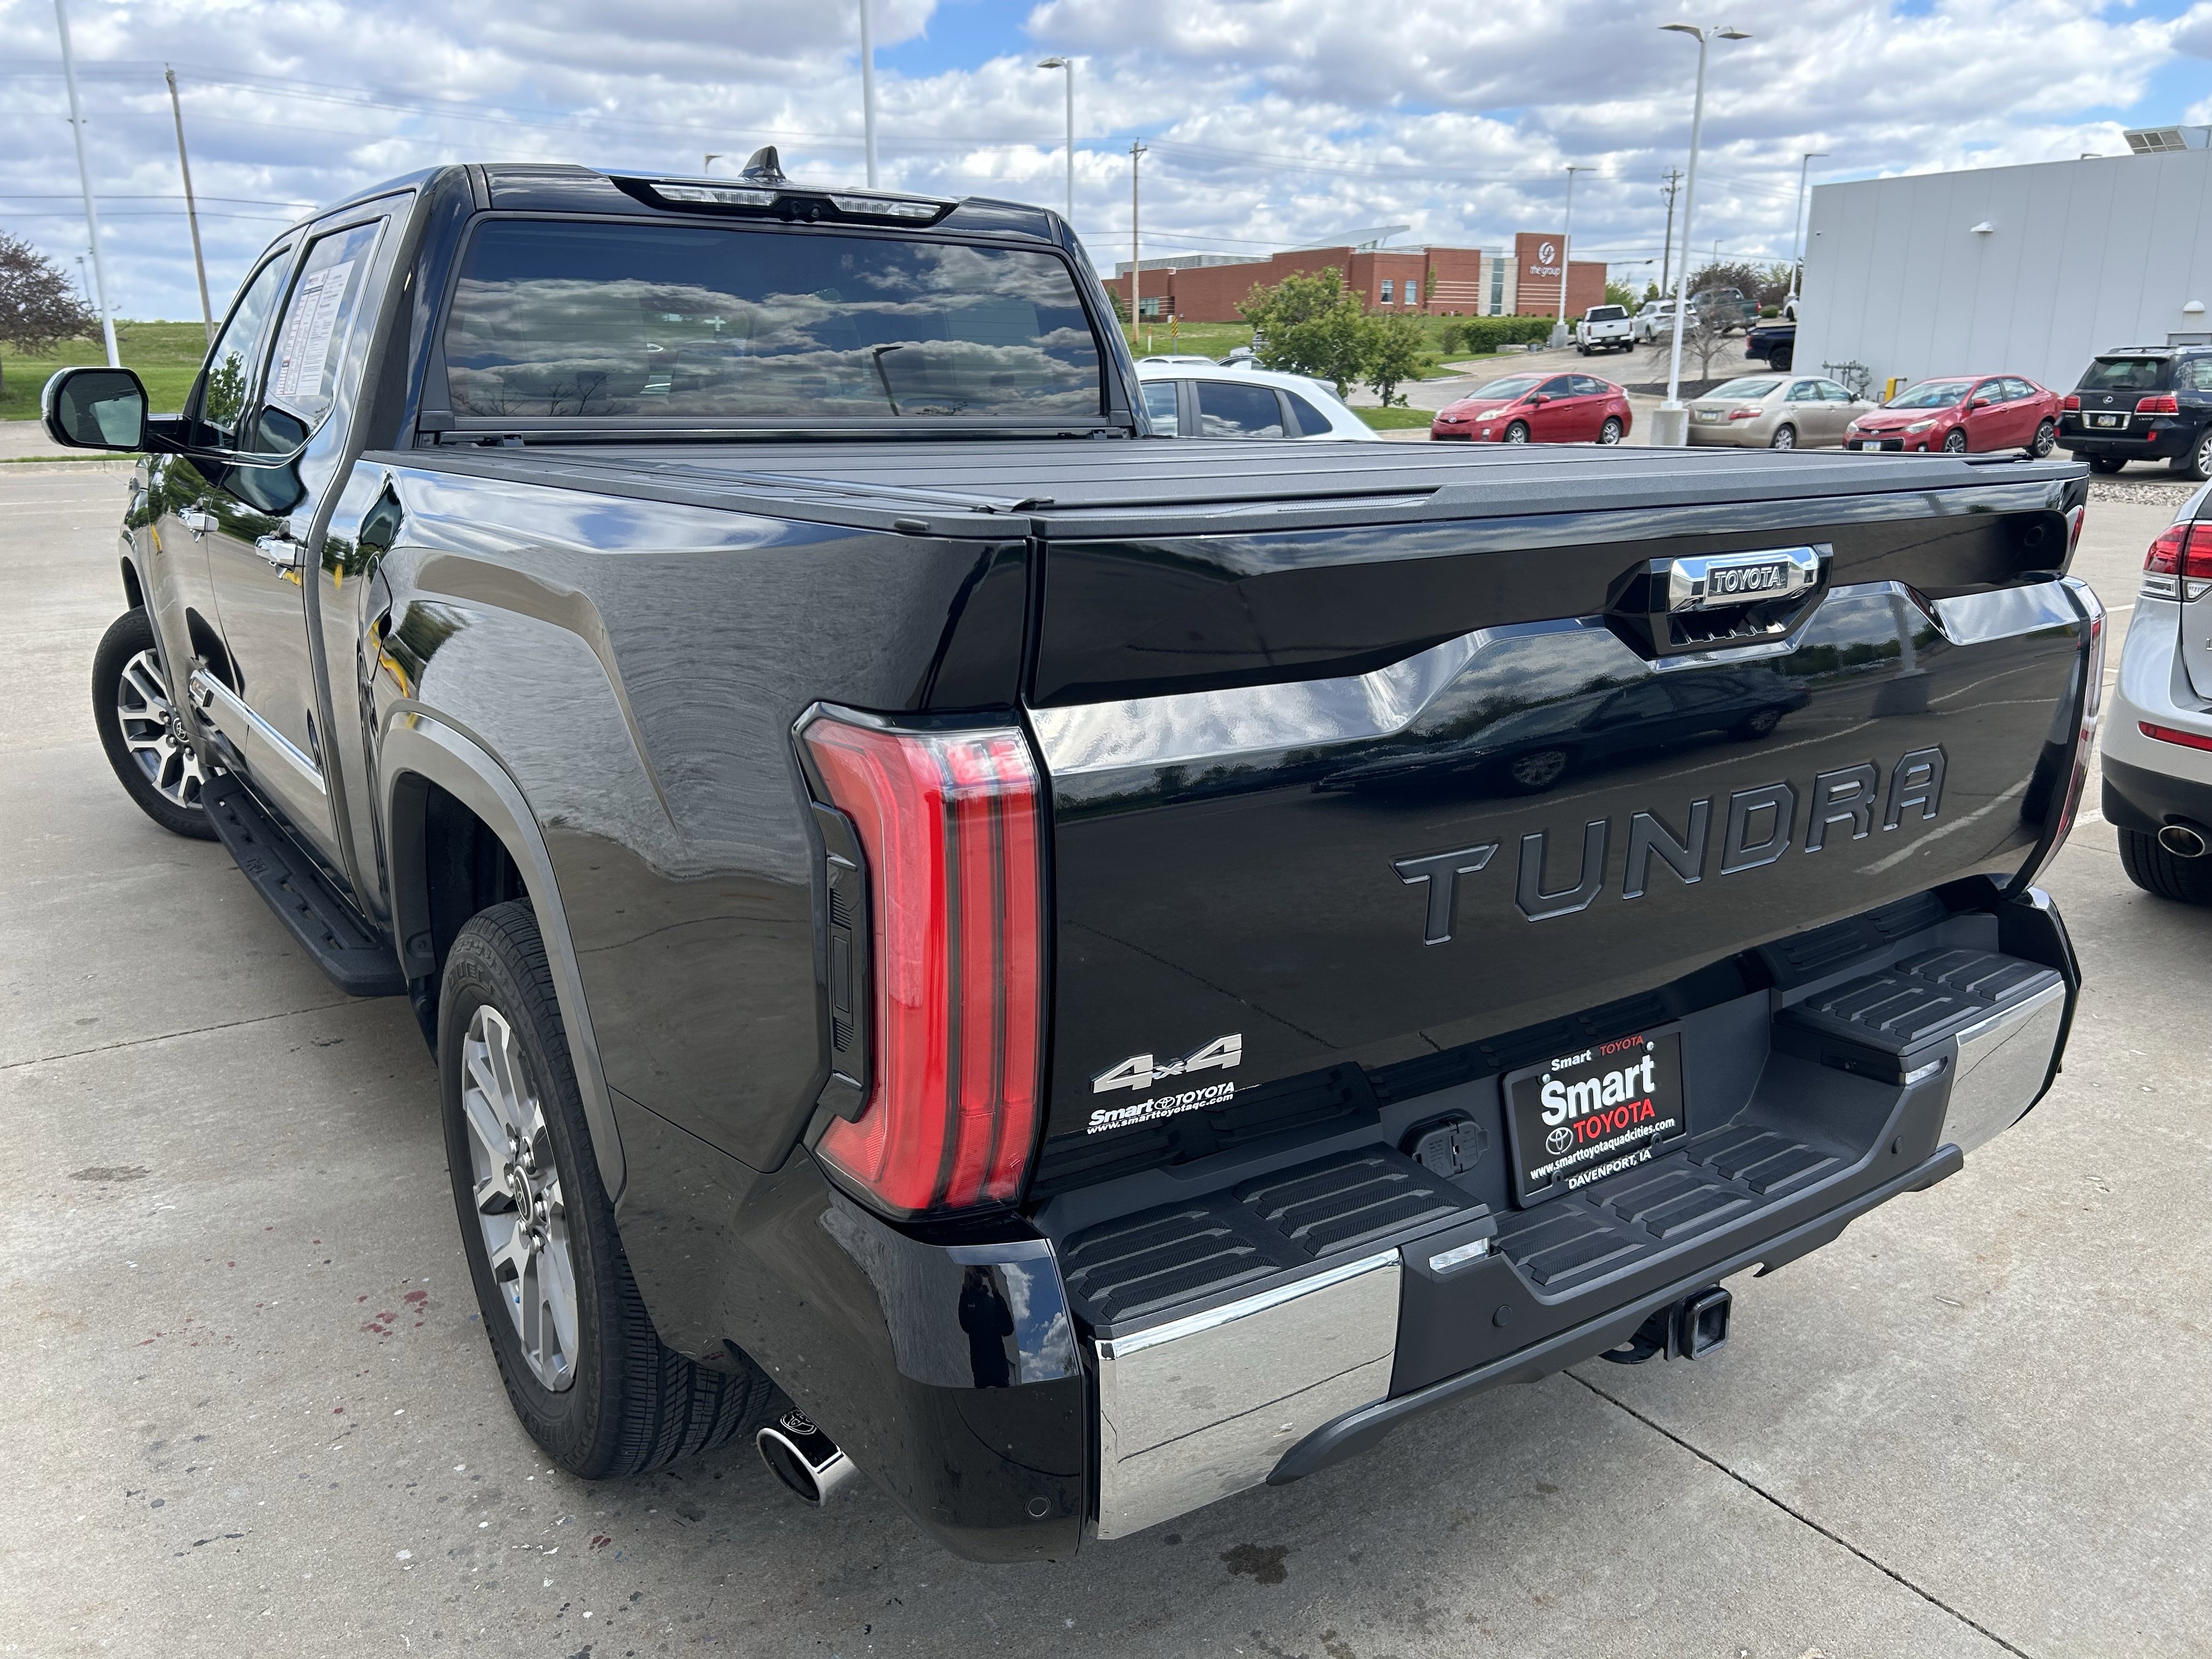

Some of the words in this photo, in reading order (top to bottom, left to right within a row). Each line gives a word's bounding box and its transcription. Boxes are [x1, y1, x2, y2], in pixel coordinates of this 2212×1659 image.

[1714, 566, 1781, 593] TOYOTA
[1389, 742, 1948, 946] TUNDRA
[1090, 1032, 1242, 1094] 4x4
[1551, 1049, 1592, 1072] Smart
[1600, 1035, 1644, 1056] TOYOTA
[1089, 1098, 1154, 1126] Smart
[1175, 1082, 1234, 1107] TOYOTA
[1541, 1054, 1655, 1126] Smart
[1087, 1093, 1233, 1135] www.smarttoyotaqc.com
[1573, 1098, 1656, 1143] TOYOTA
[1530, 1117, 1675, 1180] www.smarttoyotaquadcities.com
[1568, 1155, 1639, 1189] DAVENPORT,
[1639, 1149, 1651, 1162] IA
